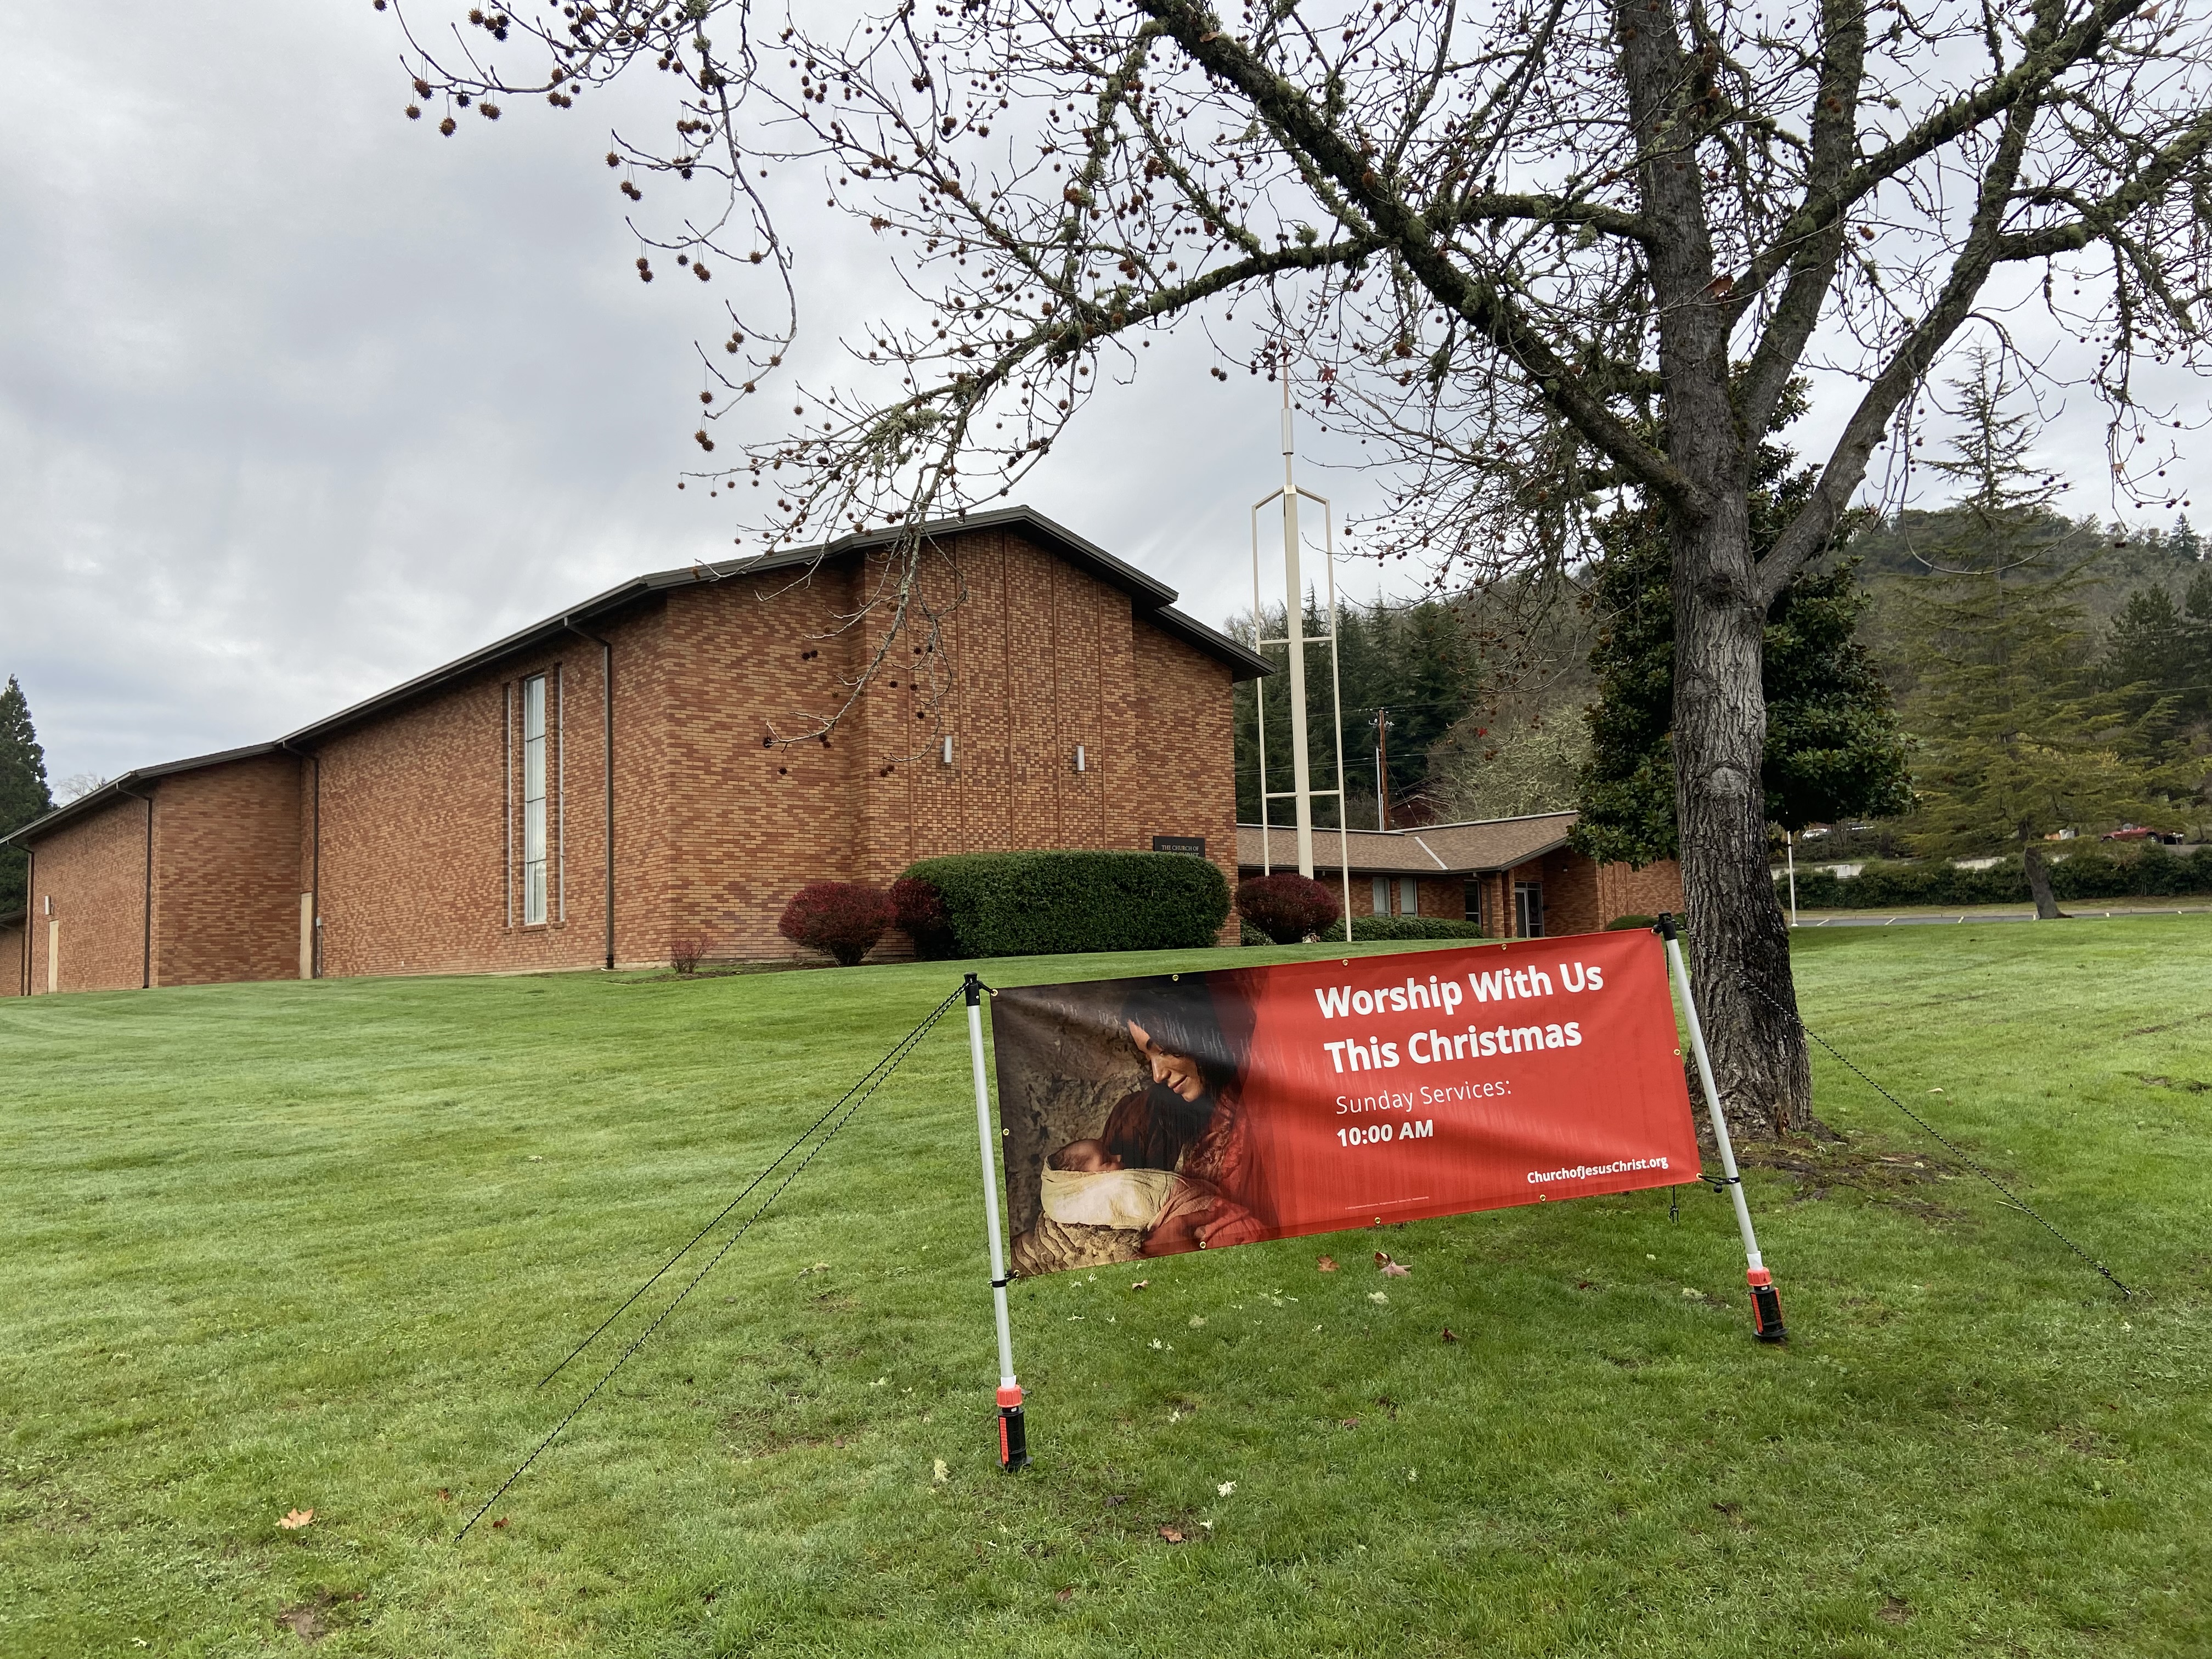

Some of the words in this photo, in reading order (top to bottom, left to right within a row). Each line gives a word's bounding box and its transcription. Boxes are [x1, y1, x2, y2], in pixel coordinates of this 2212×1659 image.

[1315, 975, 1463, 1019] Worship
[1469, 966, 1554, 1003] With
[1559, 962, 1604, 993] Us
[1324, 1036, 1400, 1074] This
[1408, 1022, 1582, 1064] Christmas
[1336, 1090, 1413, 1115] Sunday
[1420, 1080, 1512, 1105] Services:
[1337, 1124, 1393, 1147] 10:00
[1399, 1120, 1434, 1140] AM
[1527, 1156, 1669, 1184] ChurchofJesusChrist.org
